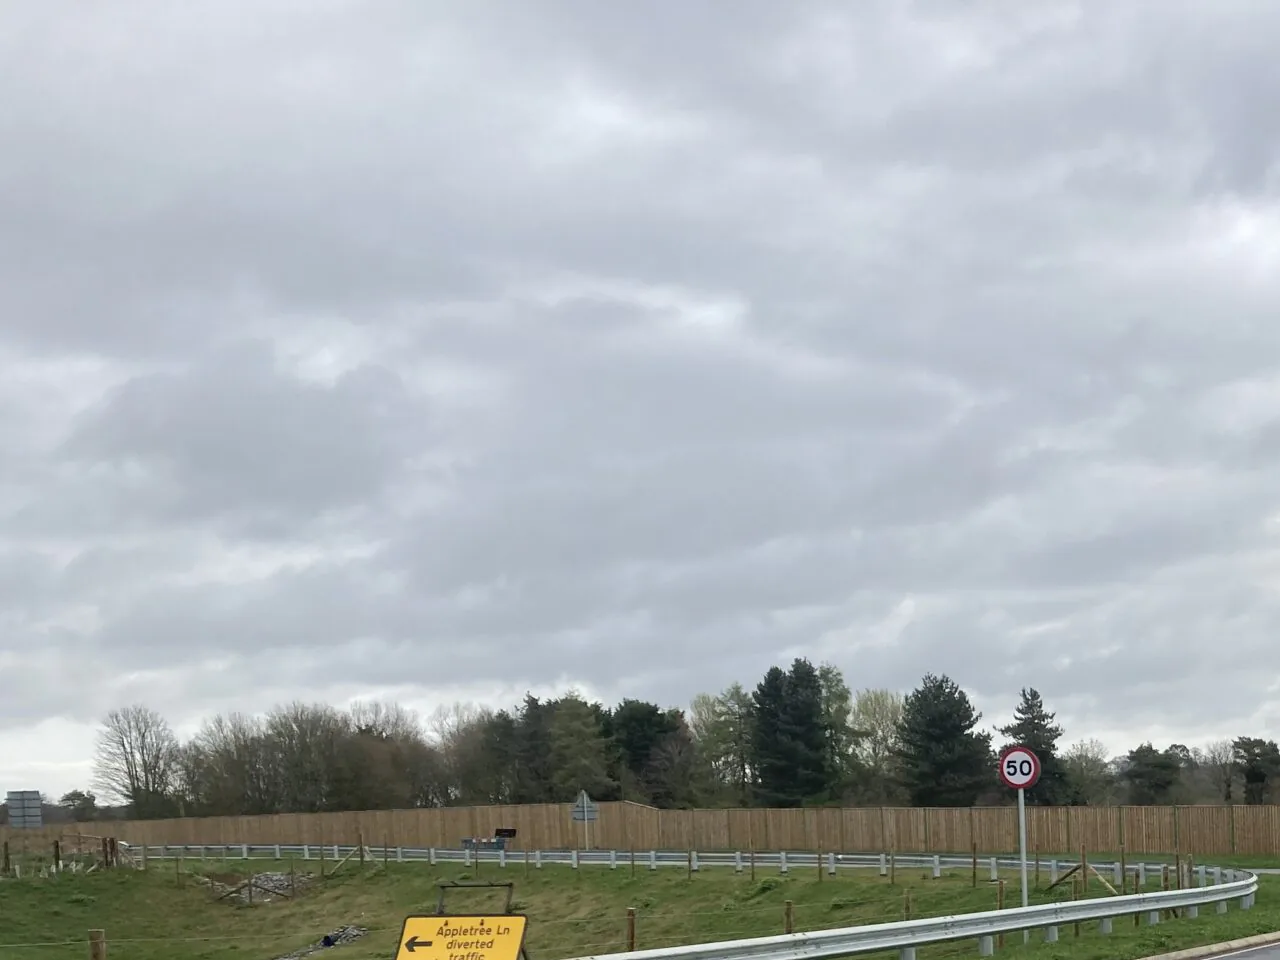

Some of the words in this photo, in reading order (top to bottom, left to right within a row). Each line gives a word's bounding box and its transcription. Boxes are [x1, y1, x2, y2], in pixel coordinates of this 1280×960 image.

[1006, 760, 1032, 776] 50
[436, 925, 492, 938] Appletree
[496, 925, 510, 935] Ln
[446, 939, 494, 950] diverted
